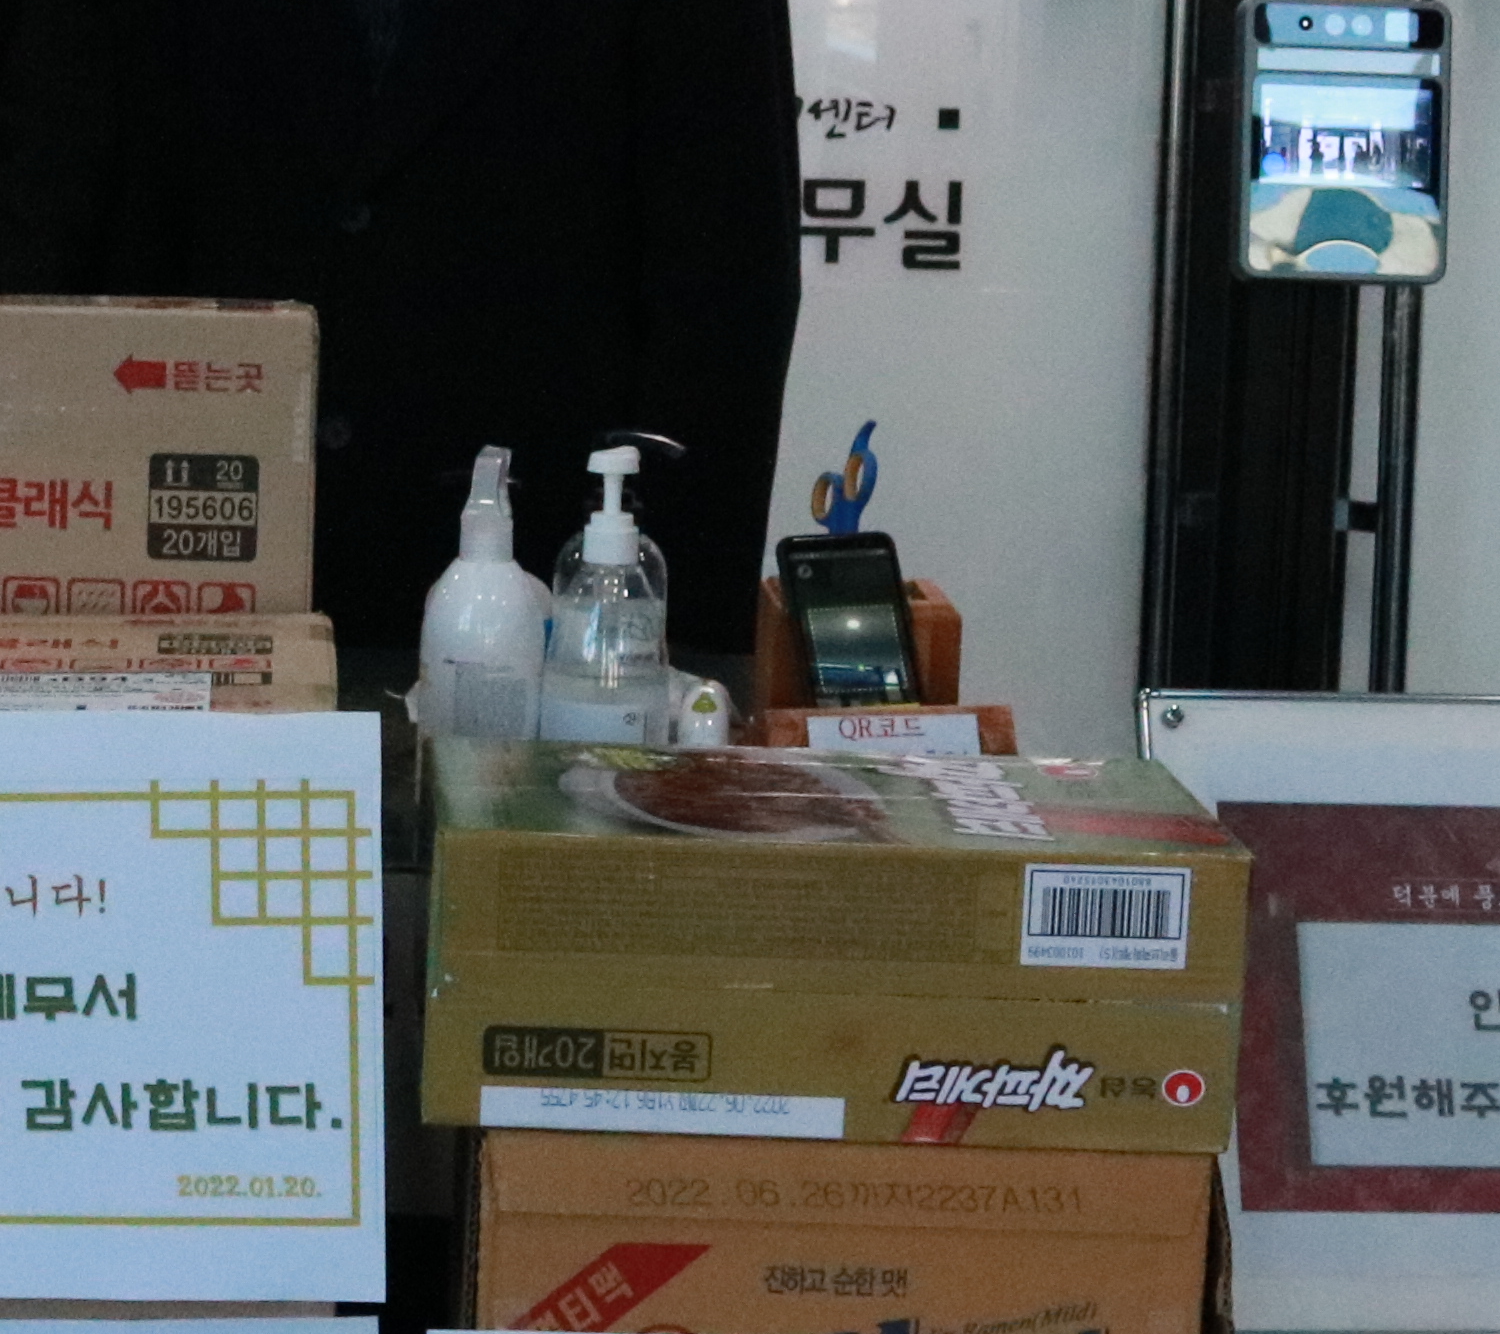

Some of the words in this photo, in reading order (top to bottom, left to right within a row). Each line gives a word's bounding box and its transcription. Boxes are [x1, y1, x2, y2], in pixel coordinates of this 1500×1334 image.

[215, 459, 245, 482] 20
[154, 495, 254, 521] 195606
[162, 529, 242, 557] 20개입
[491, 1032, 598, 1070] 20개입
[609, 1035, 702, 1075] 봉지면
[893, 1047, 1098, 1115] 짜파게티
[19, 1077, 345, 1132] 감사합니다.
[177, 1173, 324, 1199] 2022.01.20.
[763, 1266, 827, 1297] 진하고
[830, 1267, 876, 1298] 순한
